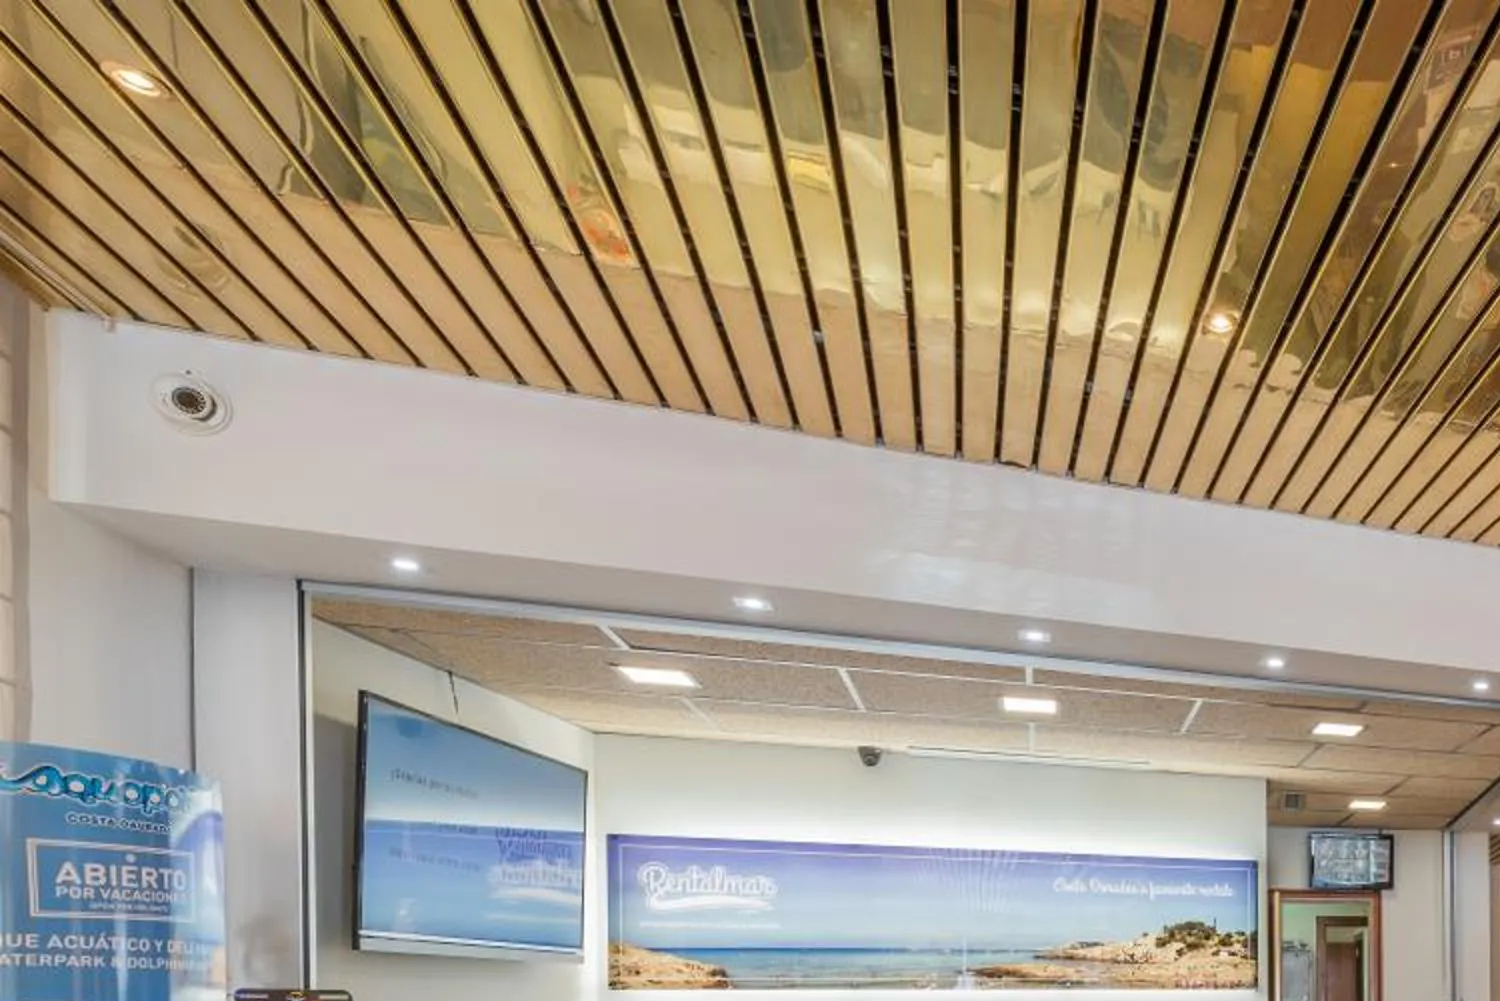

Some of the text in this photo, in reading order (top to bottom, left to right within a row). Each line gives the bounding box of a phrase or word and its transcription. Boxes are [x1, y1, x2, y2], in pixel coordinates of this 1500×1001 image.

[56, 886, 95, 899] POR
[638, 861, 778, 904] Rentalmar
[0, 932, 39, 948] UE
[154, 939, 163, 952] Y
